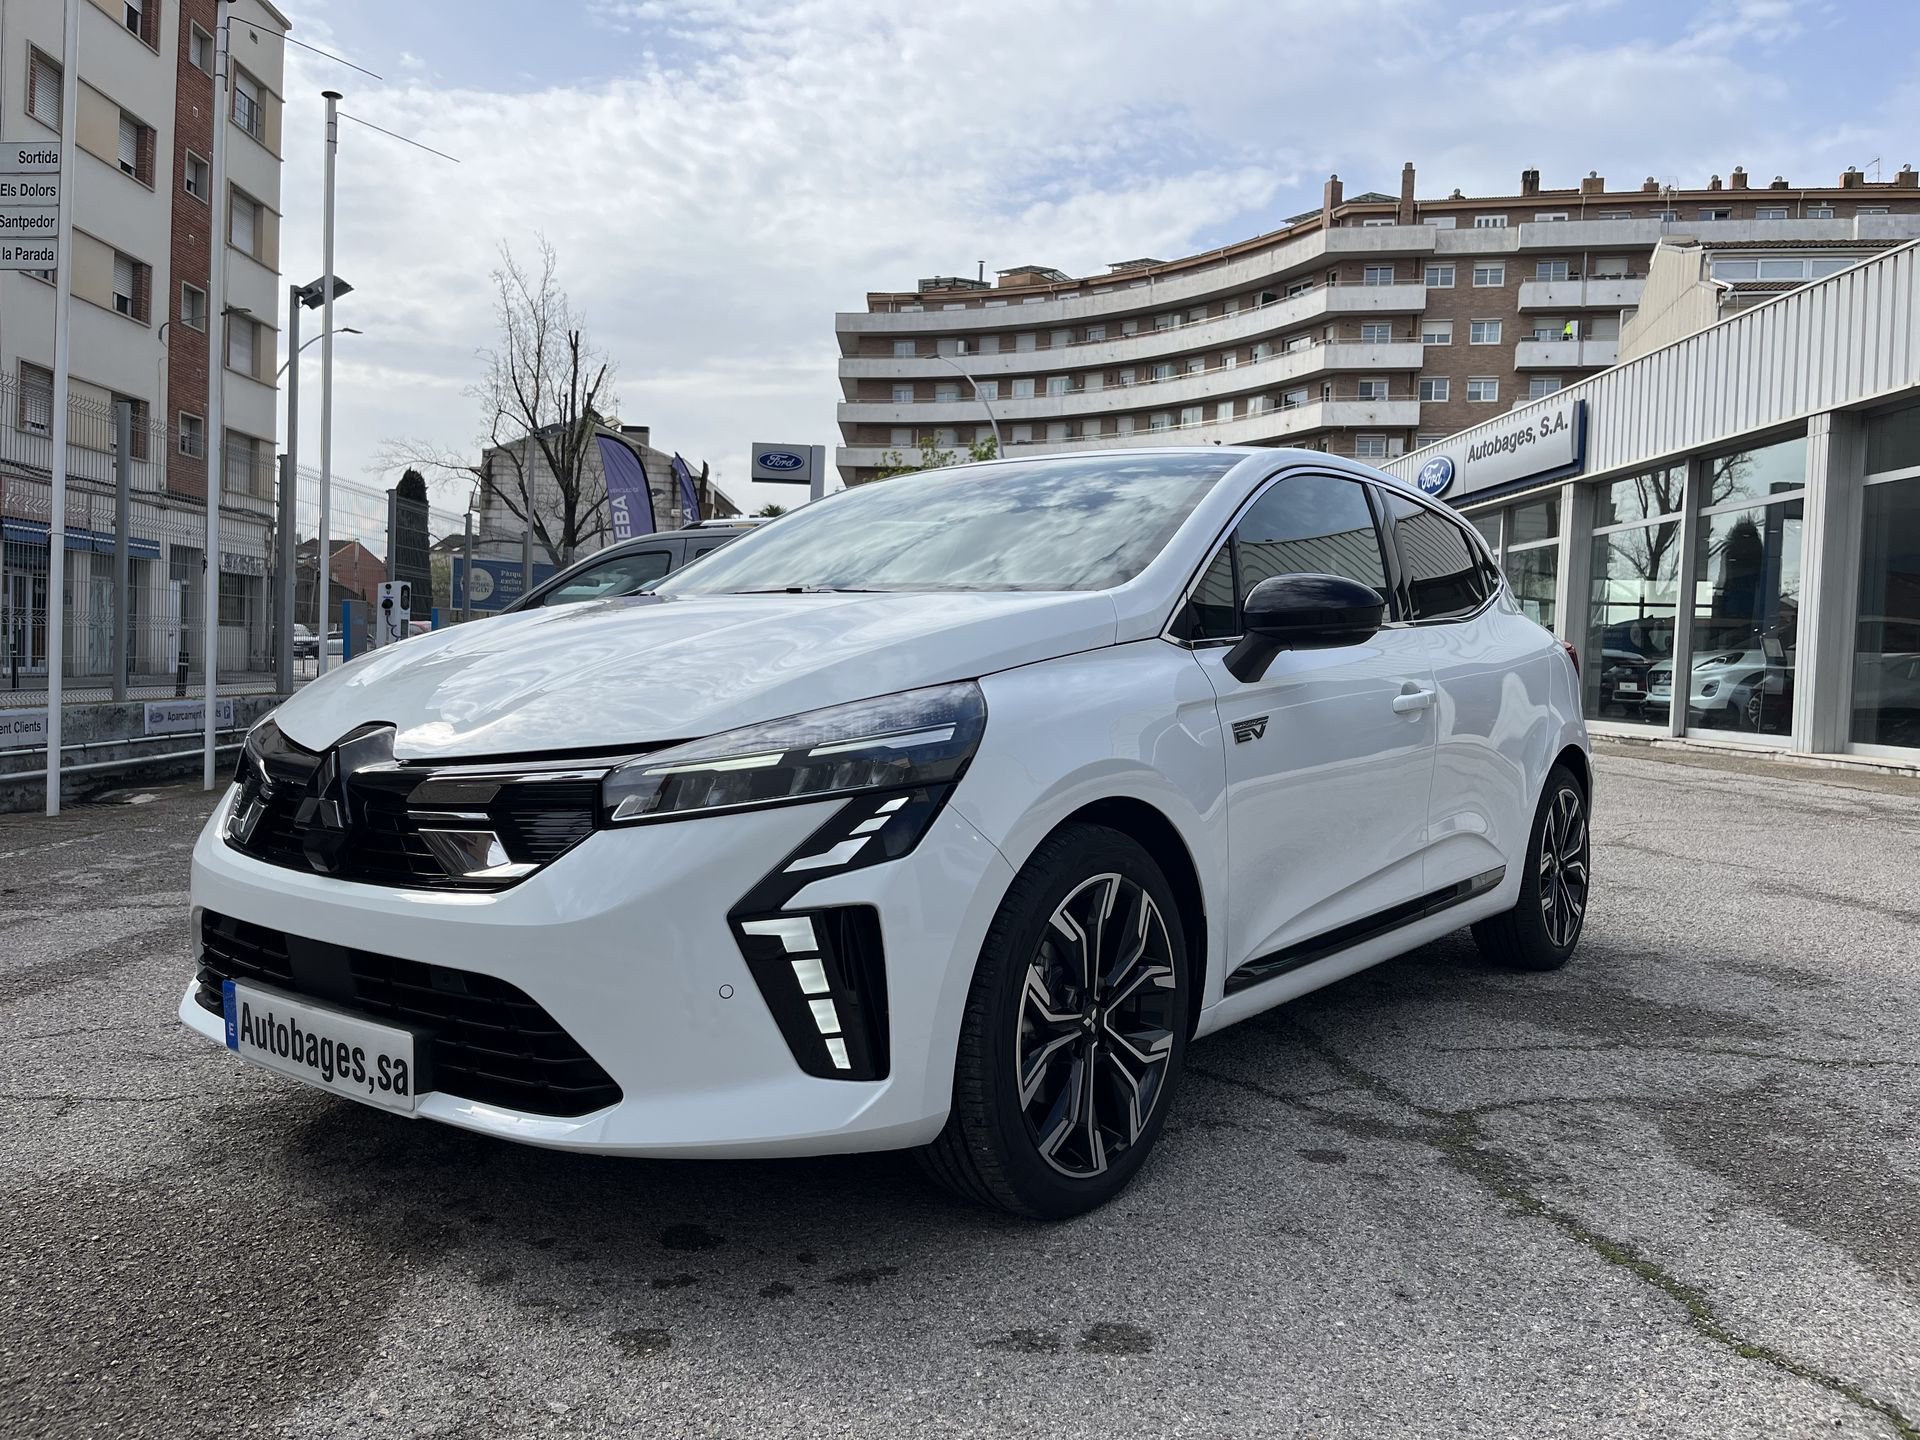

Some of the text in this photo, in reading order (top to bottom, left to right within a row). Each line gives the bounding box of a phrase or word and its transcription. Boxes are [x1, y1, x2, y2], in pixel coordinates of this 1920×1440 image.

[18, 150, 58, 164] Sortida
[0, 183, 57, 197] Els Dolors
[0, 214, 55, 231] Santpedor
[2, 247, 54, 261] la Parada
[1467, 411, 1568, 464] Autobages, S.A.
[767, 454, 795, 467] Ford
[1420, 462, 1443, 490] Ford
[611, 494, 632, 541] EBA
[167, 710, 202, 722] Aparcament
[14, 720, 41, 734] Clients
[1232, 718, 1268, 745] EV
[228, 1022, 235, 1037] E
[240, 1001, 409, 1097] Autobages,sa
